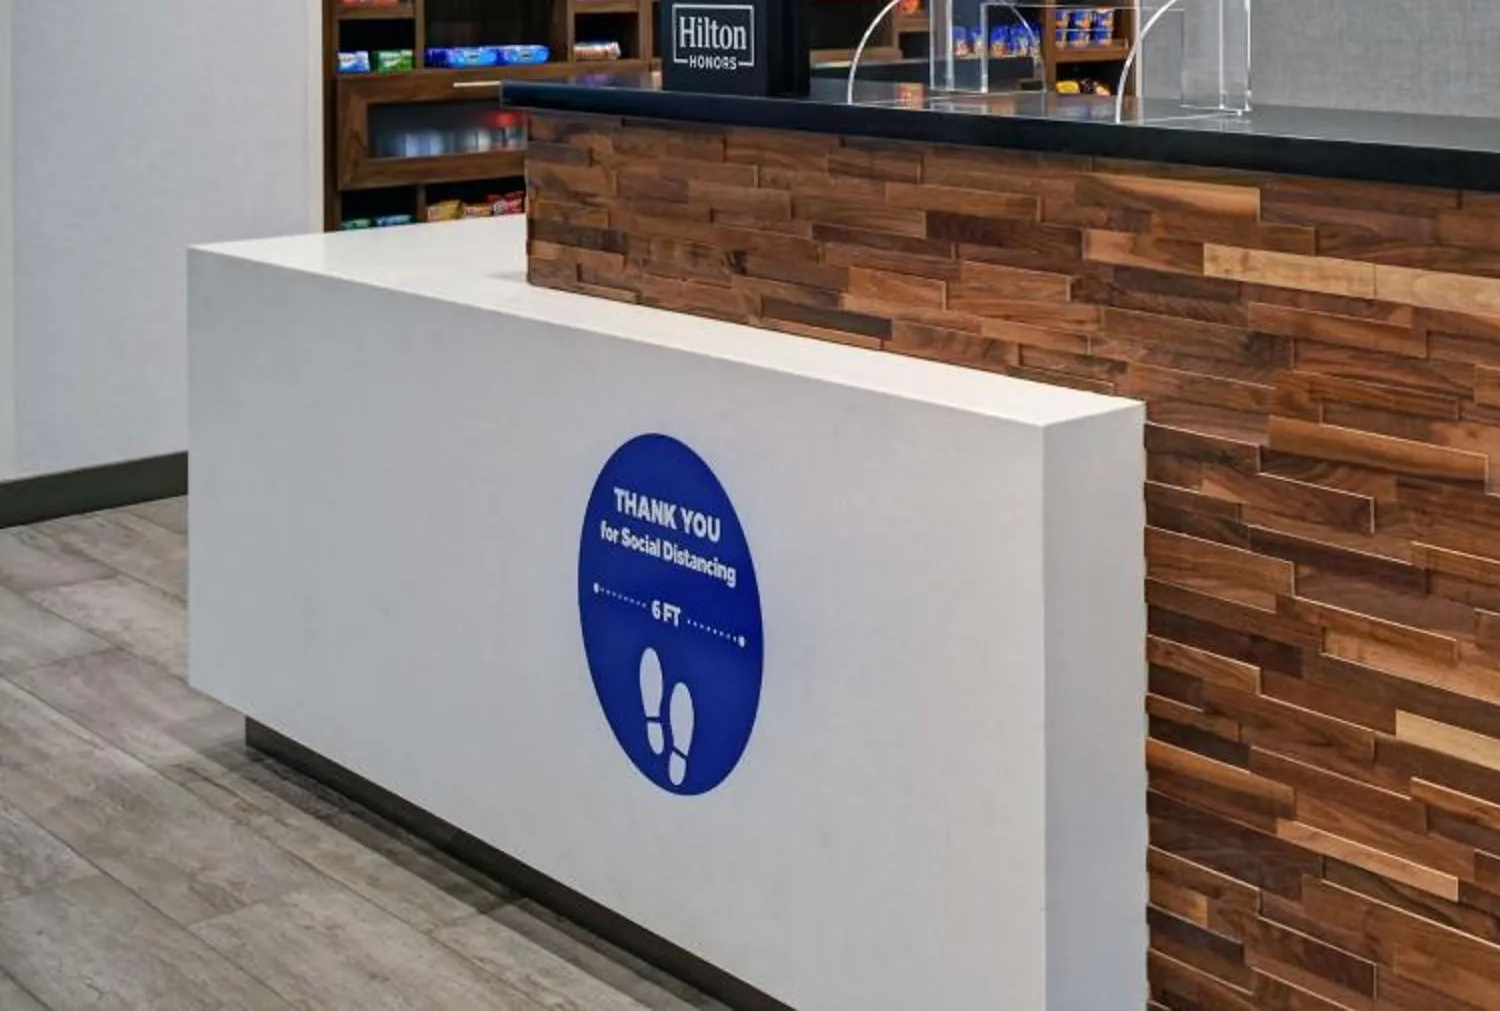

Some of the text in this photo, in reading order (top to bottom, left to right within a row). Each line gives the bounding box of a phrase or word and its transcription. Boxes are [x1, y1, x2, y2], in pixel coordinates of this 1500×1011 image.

[679, 16, 747, 50] Hilton
[689, 55, 737, 70] HONORS
[613, 487, 720, 542] THANK YOU
[601, 520, 736, 588] for Social Distancing
[652, 600, 681, 627] 6 FT
